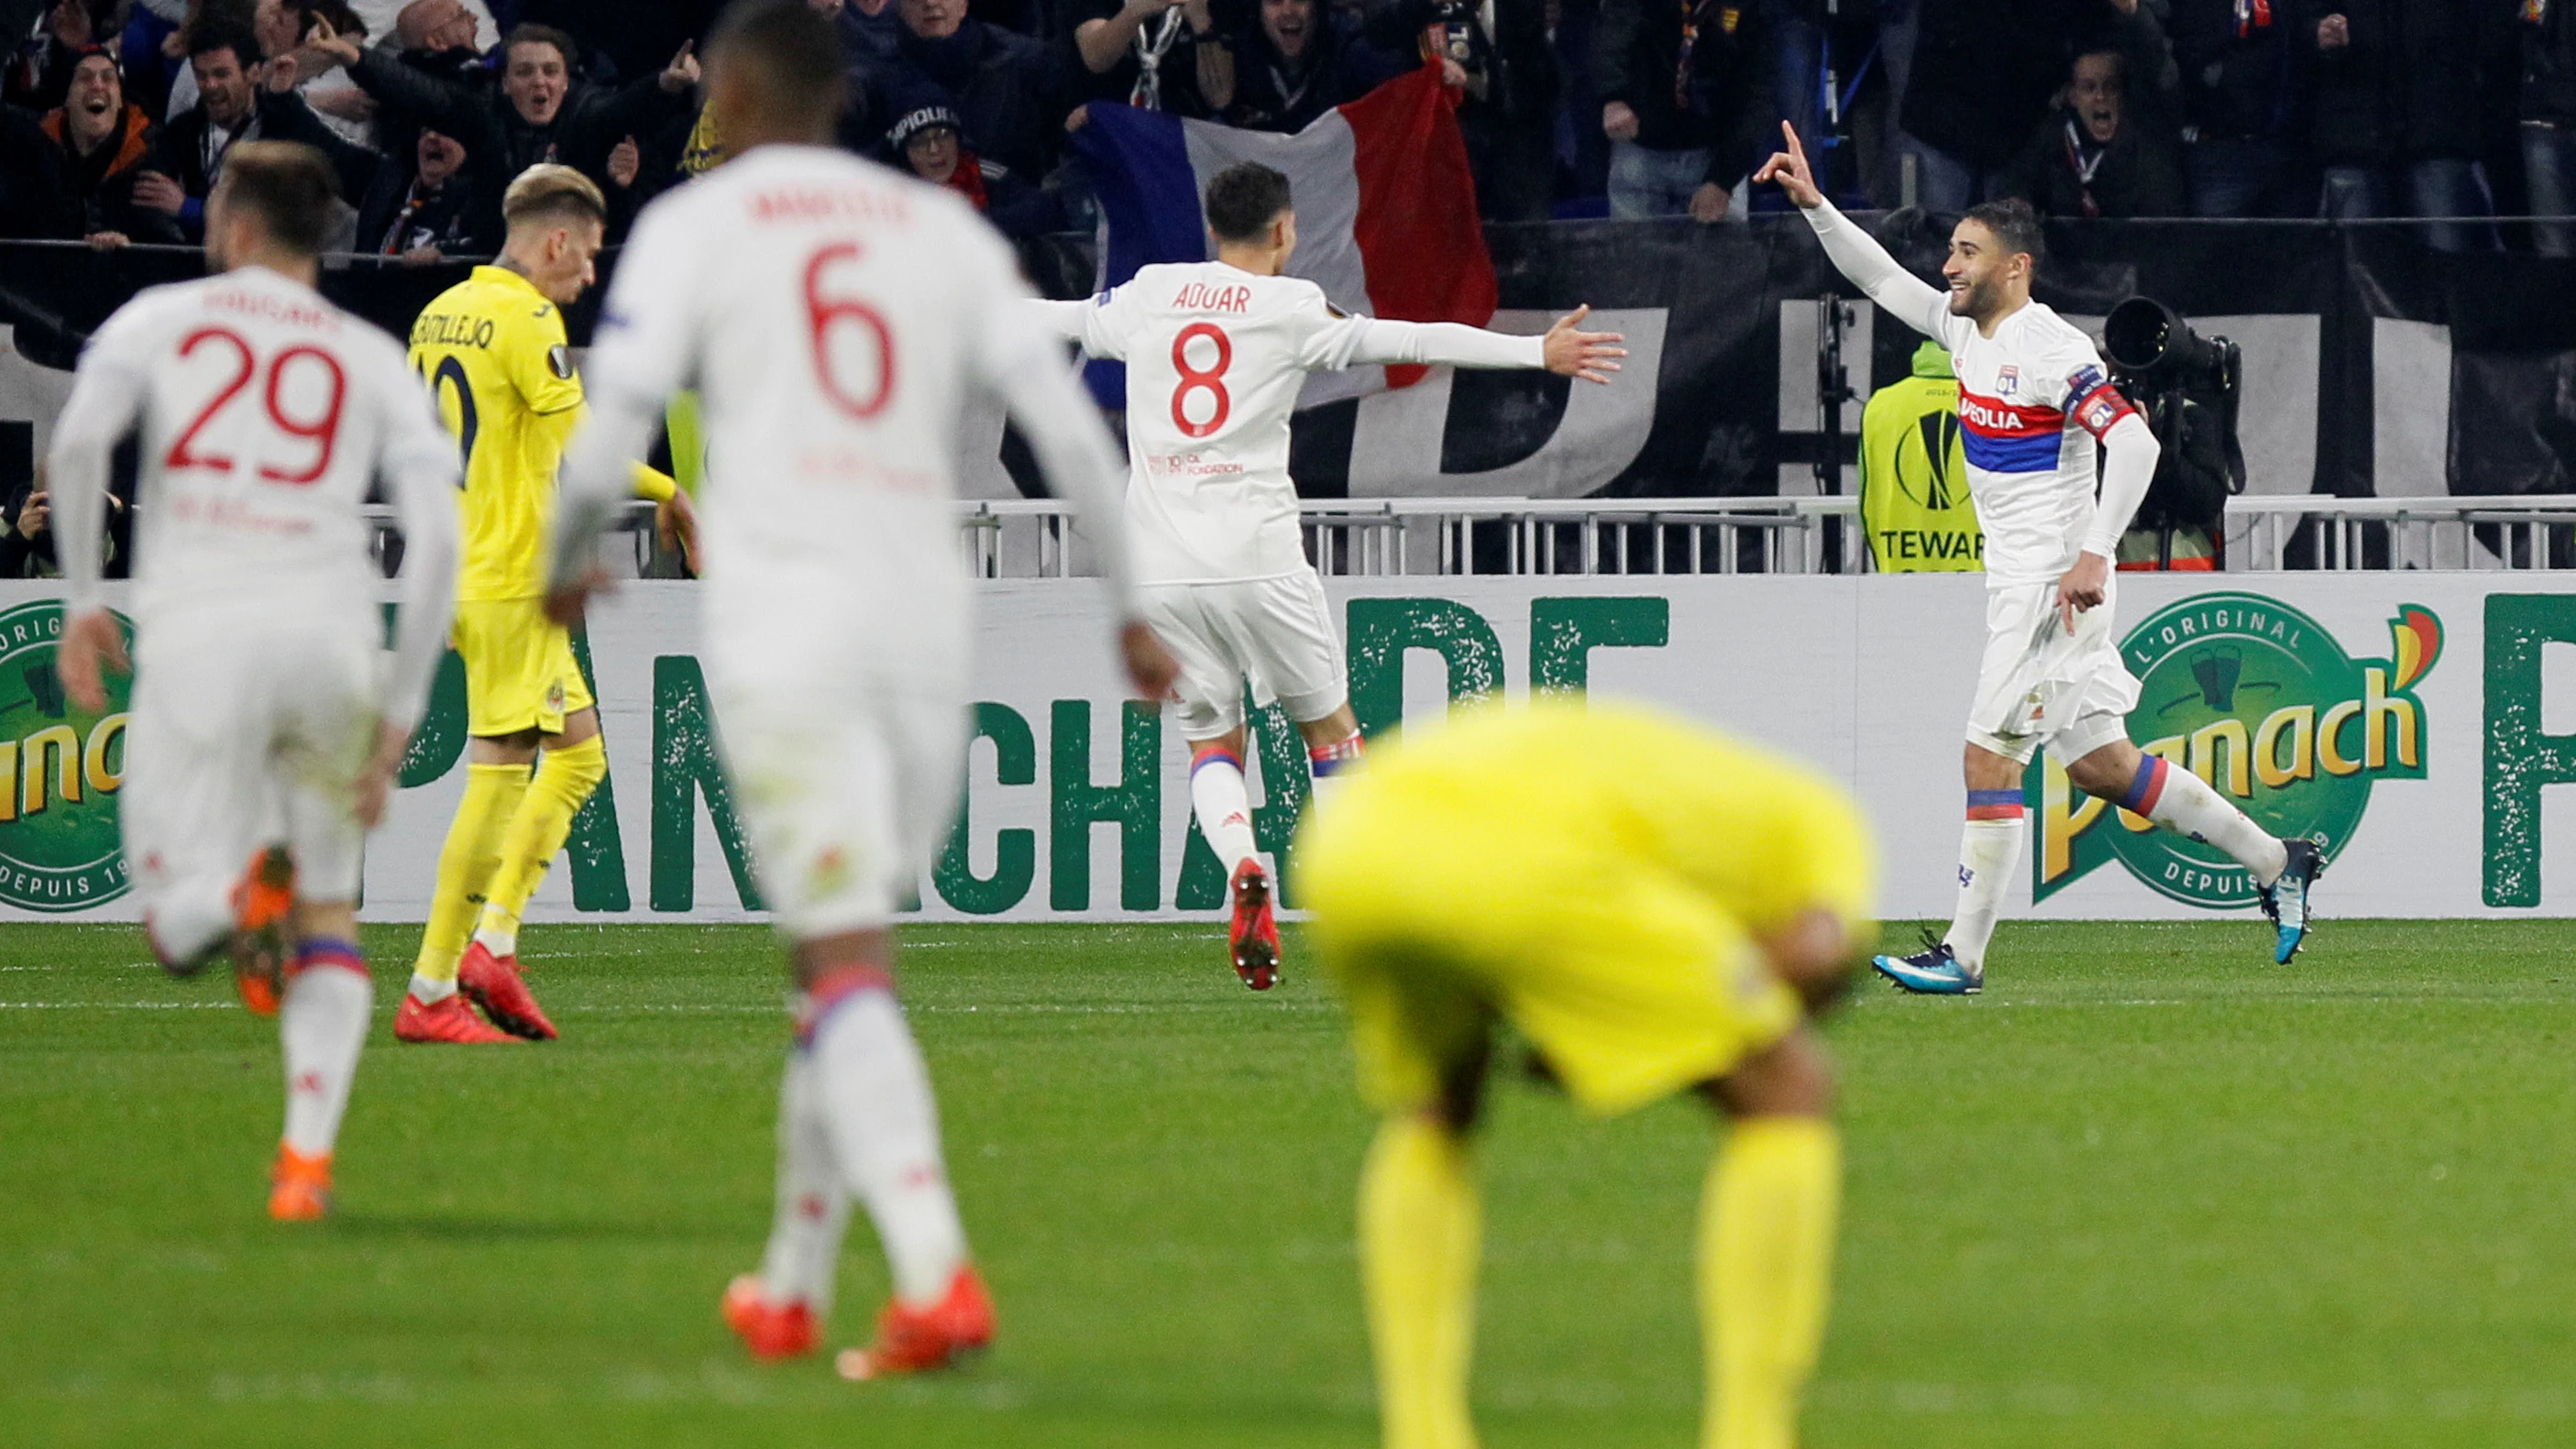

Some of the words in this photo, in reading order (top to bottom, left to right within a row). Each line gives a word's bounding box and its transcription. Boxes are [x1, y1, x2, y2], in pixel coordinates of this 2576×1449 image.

[1172, 283, 1250, 313] AOUAR
[803, 240, 897, 423] 6
[1172, 323, 1232, 438] 8
[1998, 377, 2016, 393] OL
[165, 327, 347, 485] 29
[2090, 405, 2114, 428] OL
[2134, 609, 2302, 664] L'ORIGINAL
[2163, 862, 2258, 895] DEPUIS
